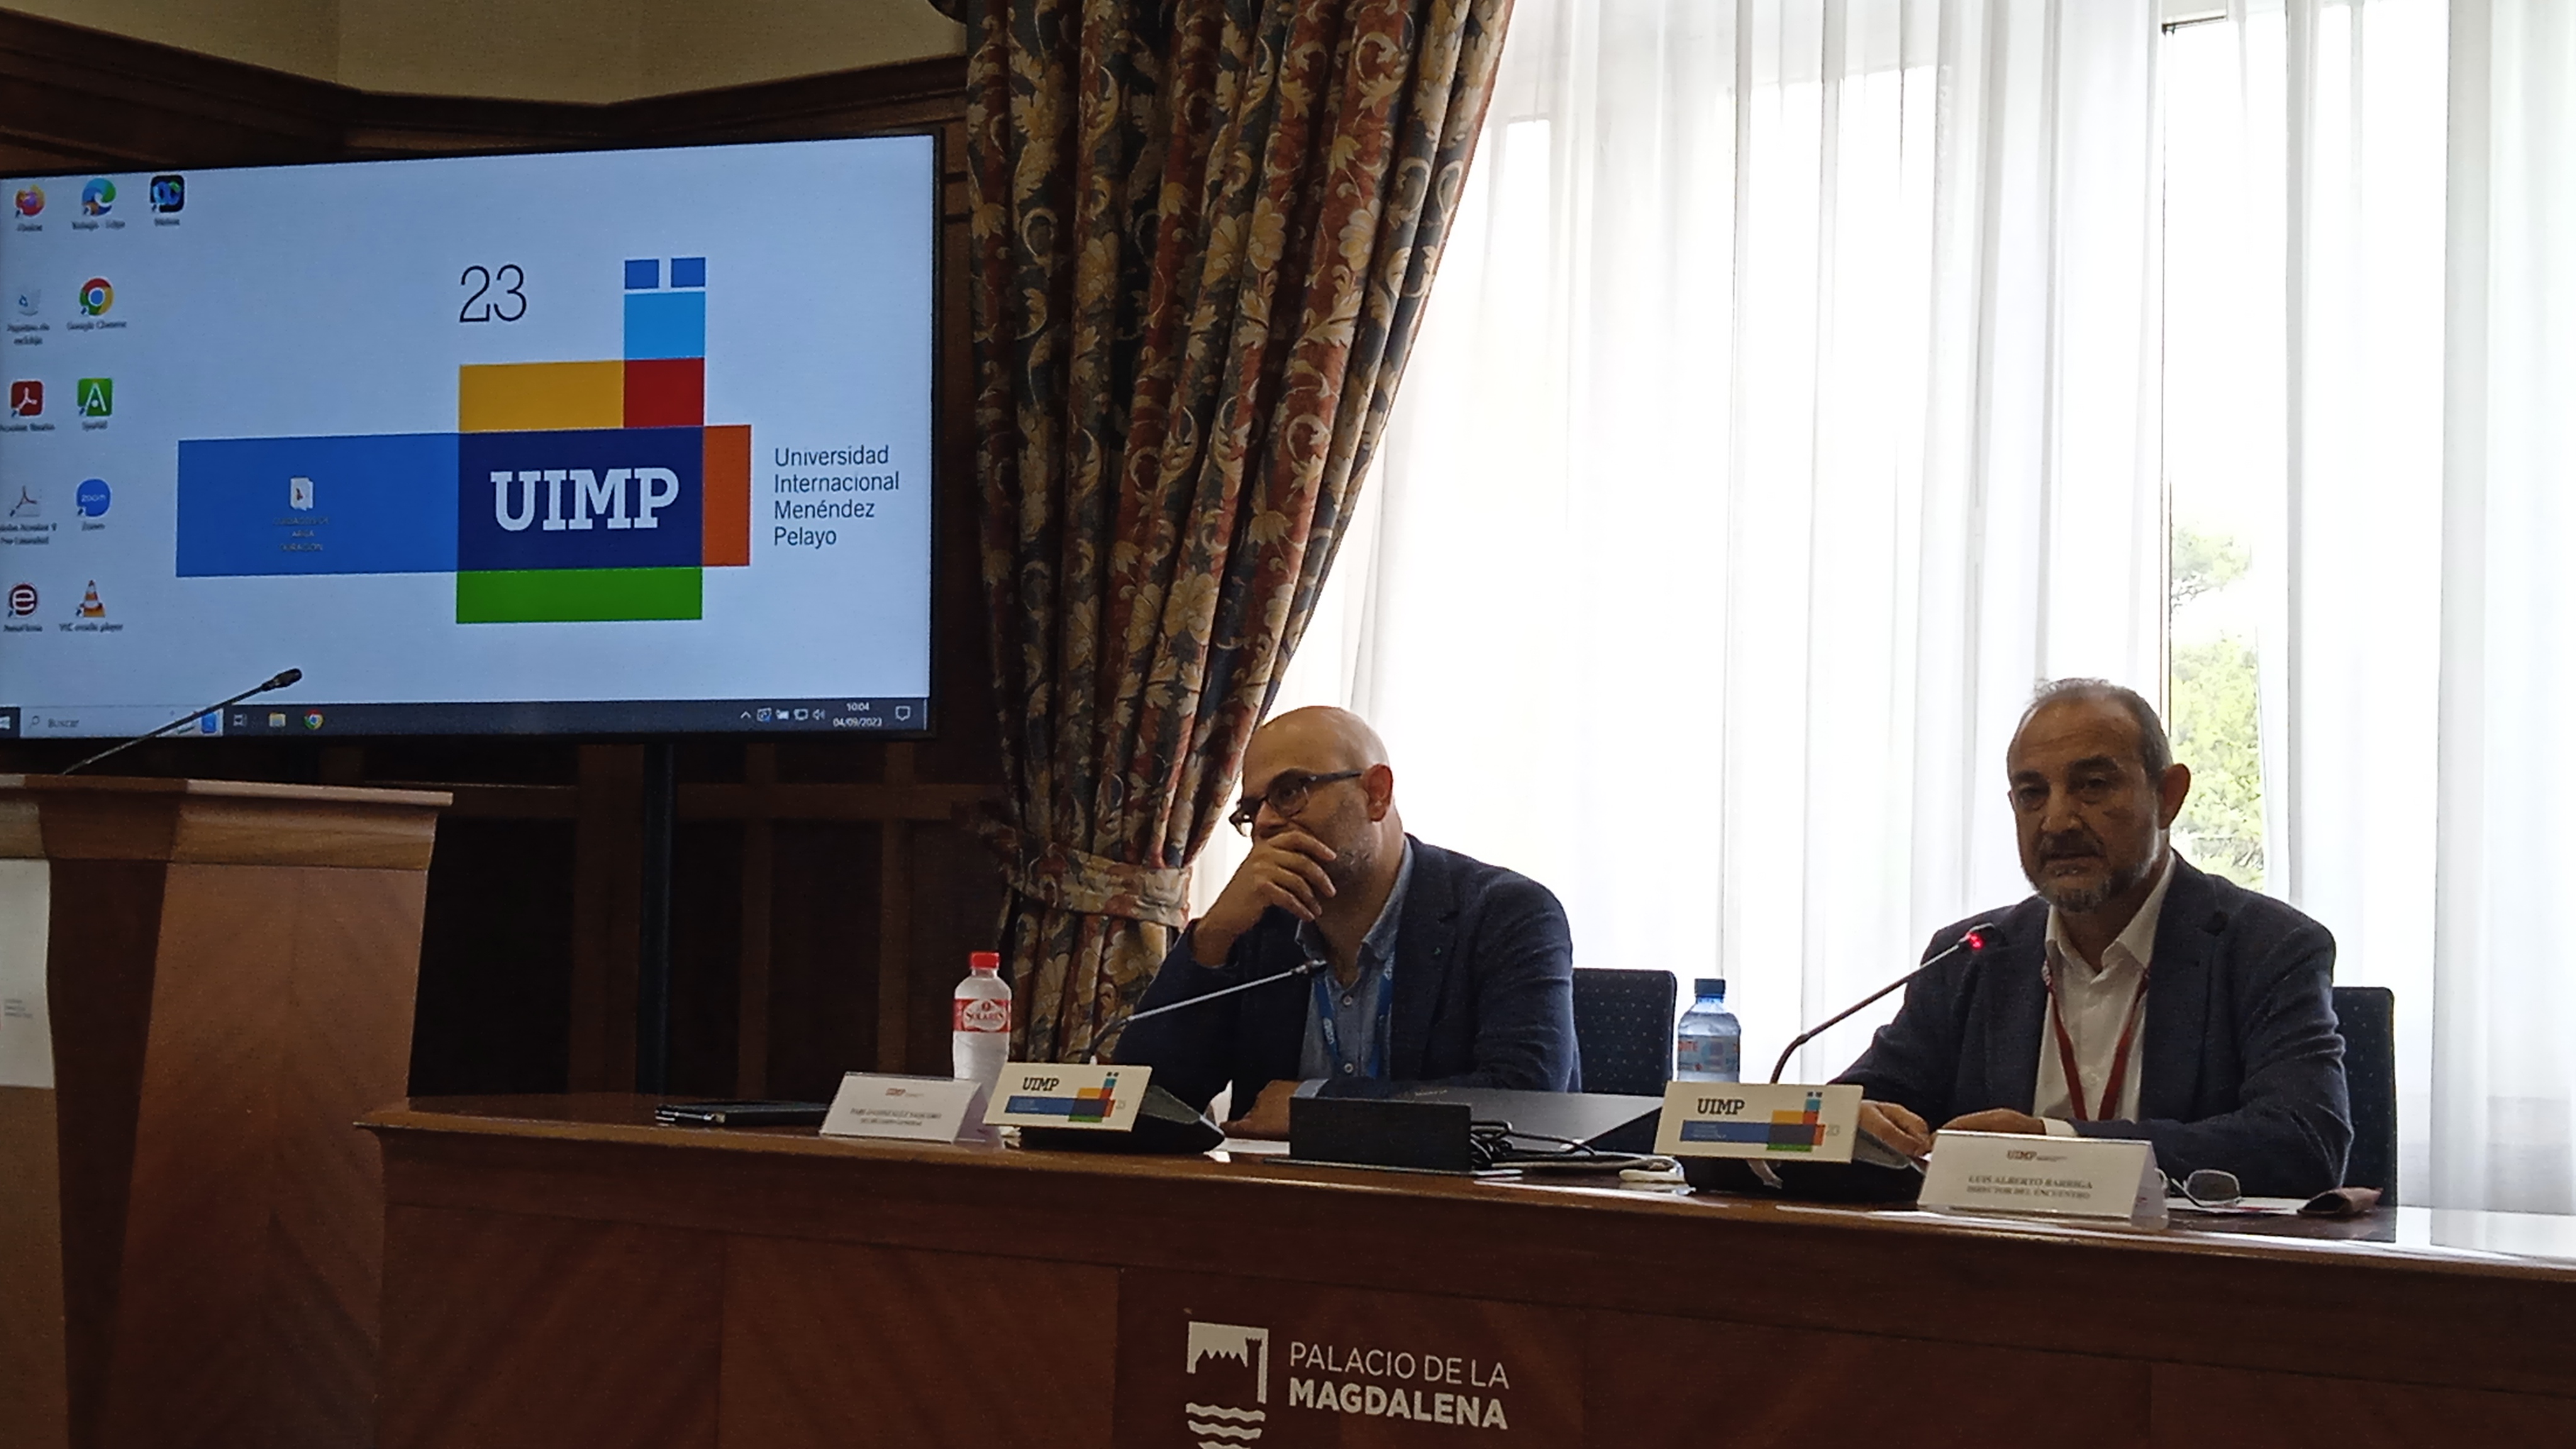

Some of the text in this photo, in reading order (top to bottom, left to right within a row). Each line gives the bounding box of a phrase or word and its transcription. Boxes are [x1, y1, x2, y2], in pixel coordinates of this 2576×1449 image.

[459, 264, 526, 323] 23
[774, 444, 889, 467] Universidad
[774, 470, 900, 494] Internacional
[491, 467, 680, 531] UIMP
[774, 501, 875, 519] Menéndez
[774, 526, 838, 549] Pelayo
[847, 702, 870, 711] 10:04
[1023, 1077, 1060, 1092] UIMP
[1697, 1098, 1745, 1116] UIMP
[1290, 1341, 1510, 1390] PALACIO DE LA
[1289, 1377, 1509, 1431] MAGDALENA
